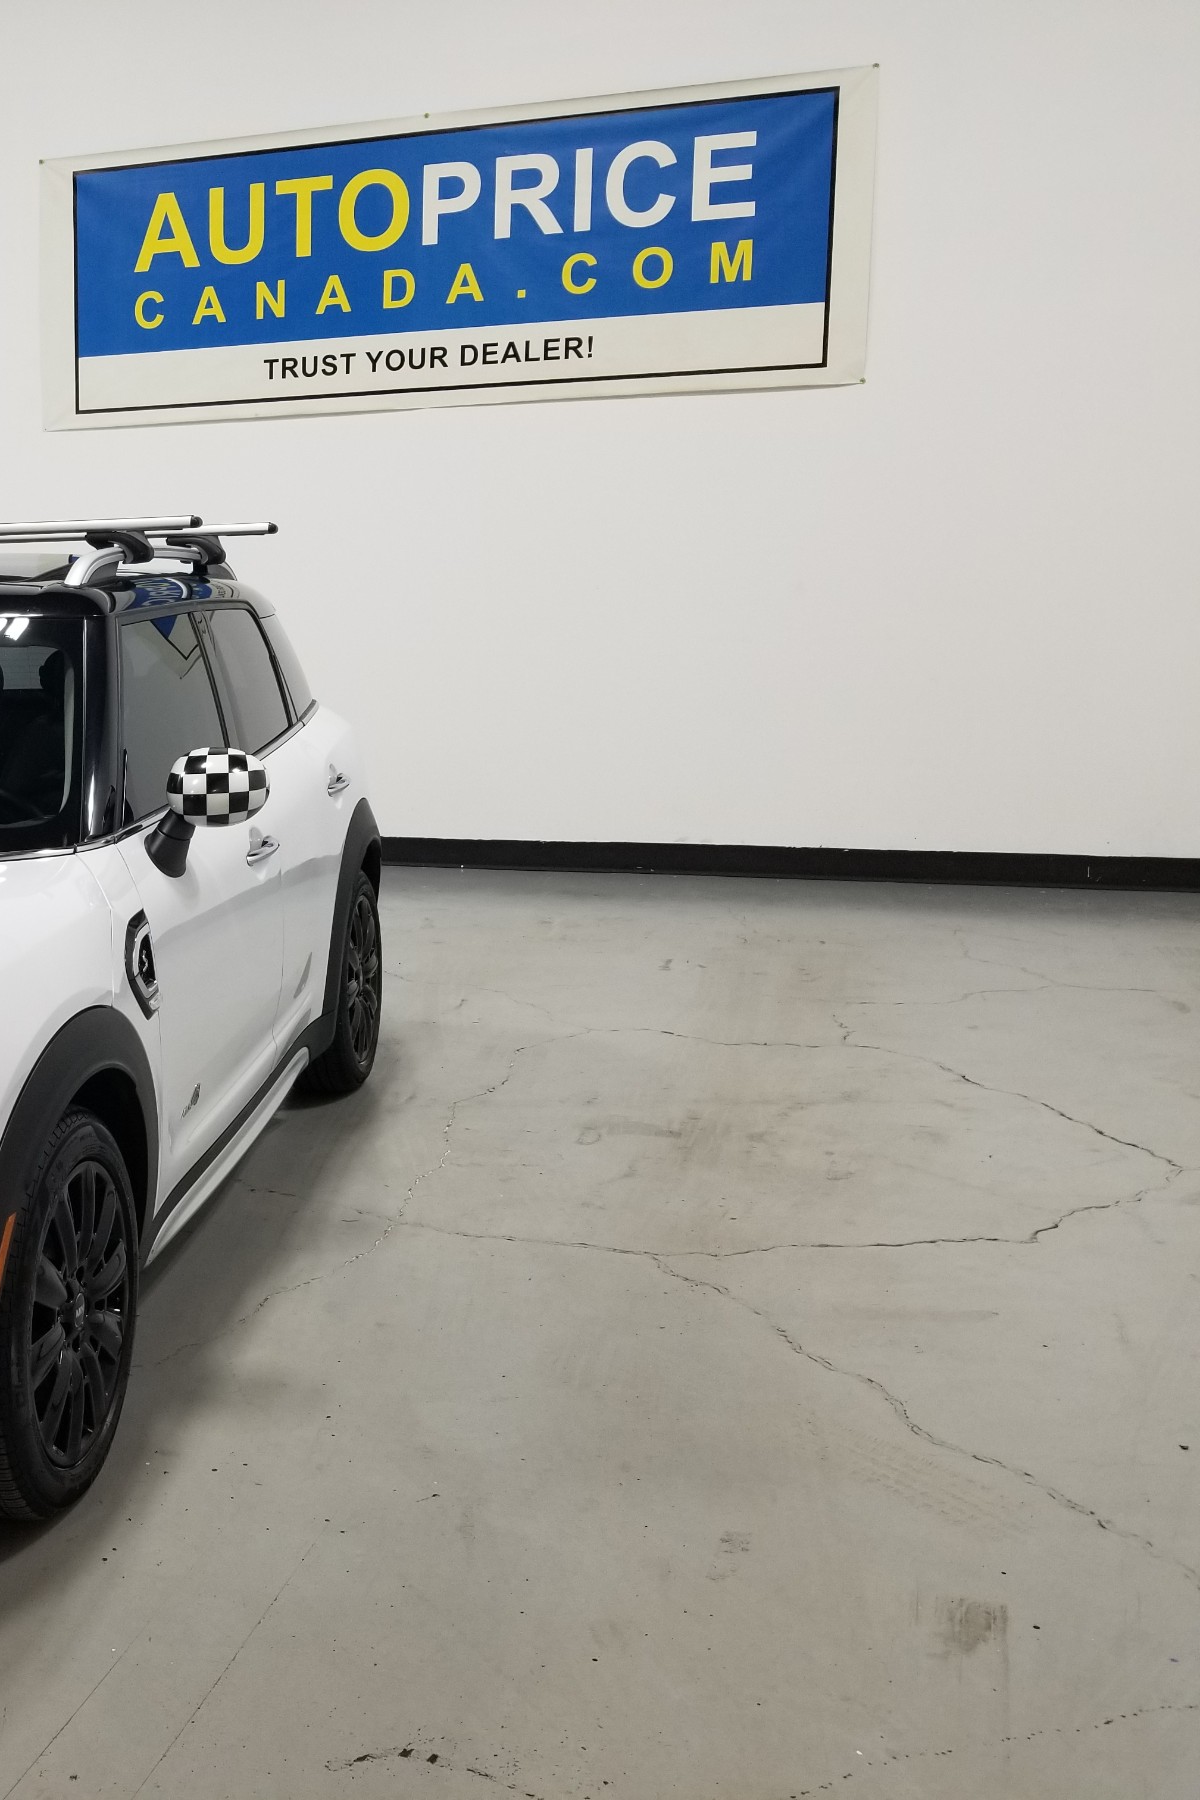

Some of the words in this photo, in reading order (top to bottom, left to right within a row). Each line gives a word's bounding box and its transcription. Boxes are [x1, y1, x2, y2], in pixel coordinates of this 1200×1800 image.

[134, 130, 758, 273] AUTOPRICE
[263, 352, 357, 380] TRUST
[365, 346, 449, 373] YOUR
[460, 335, 594, 367] DEALER!
